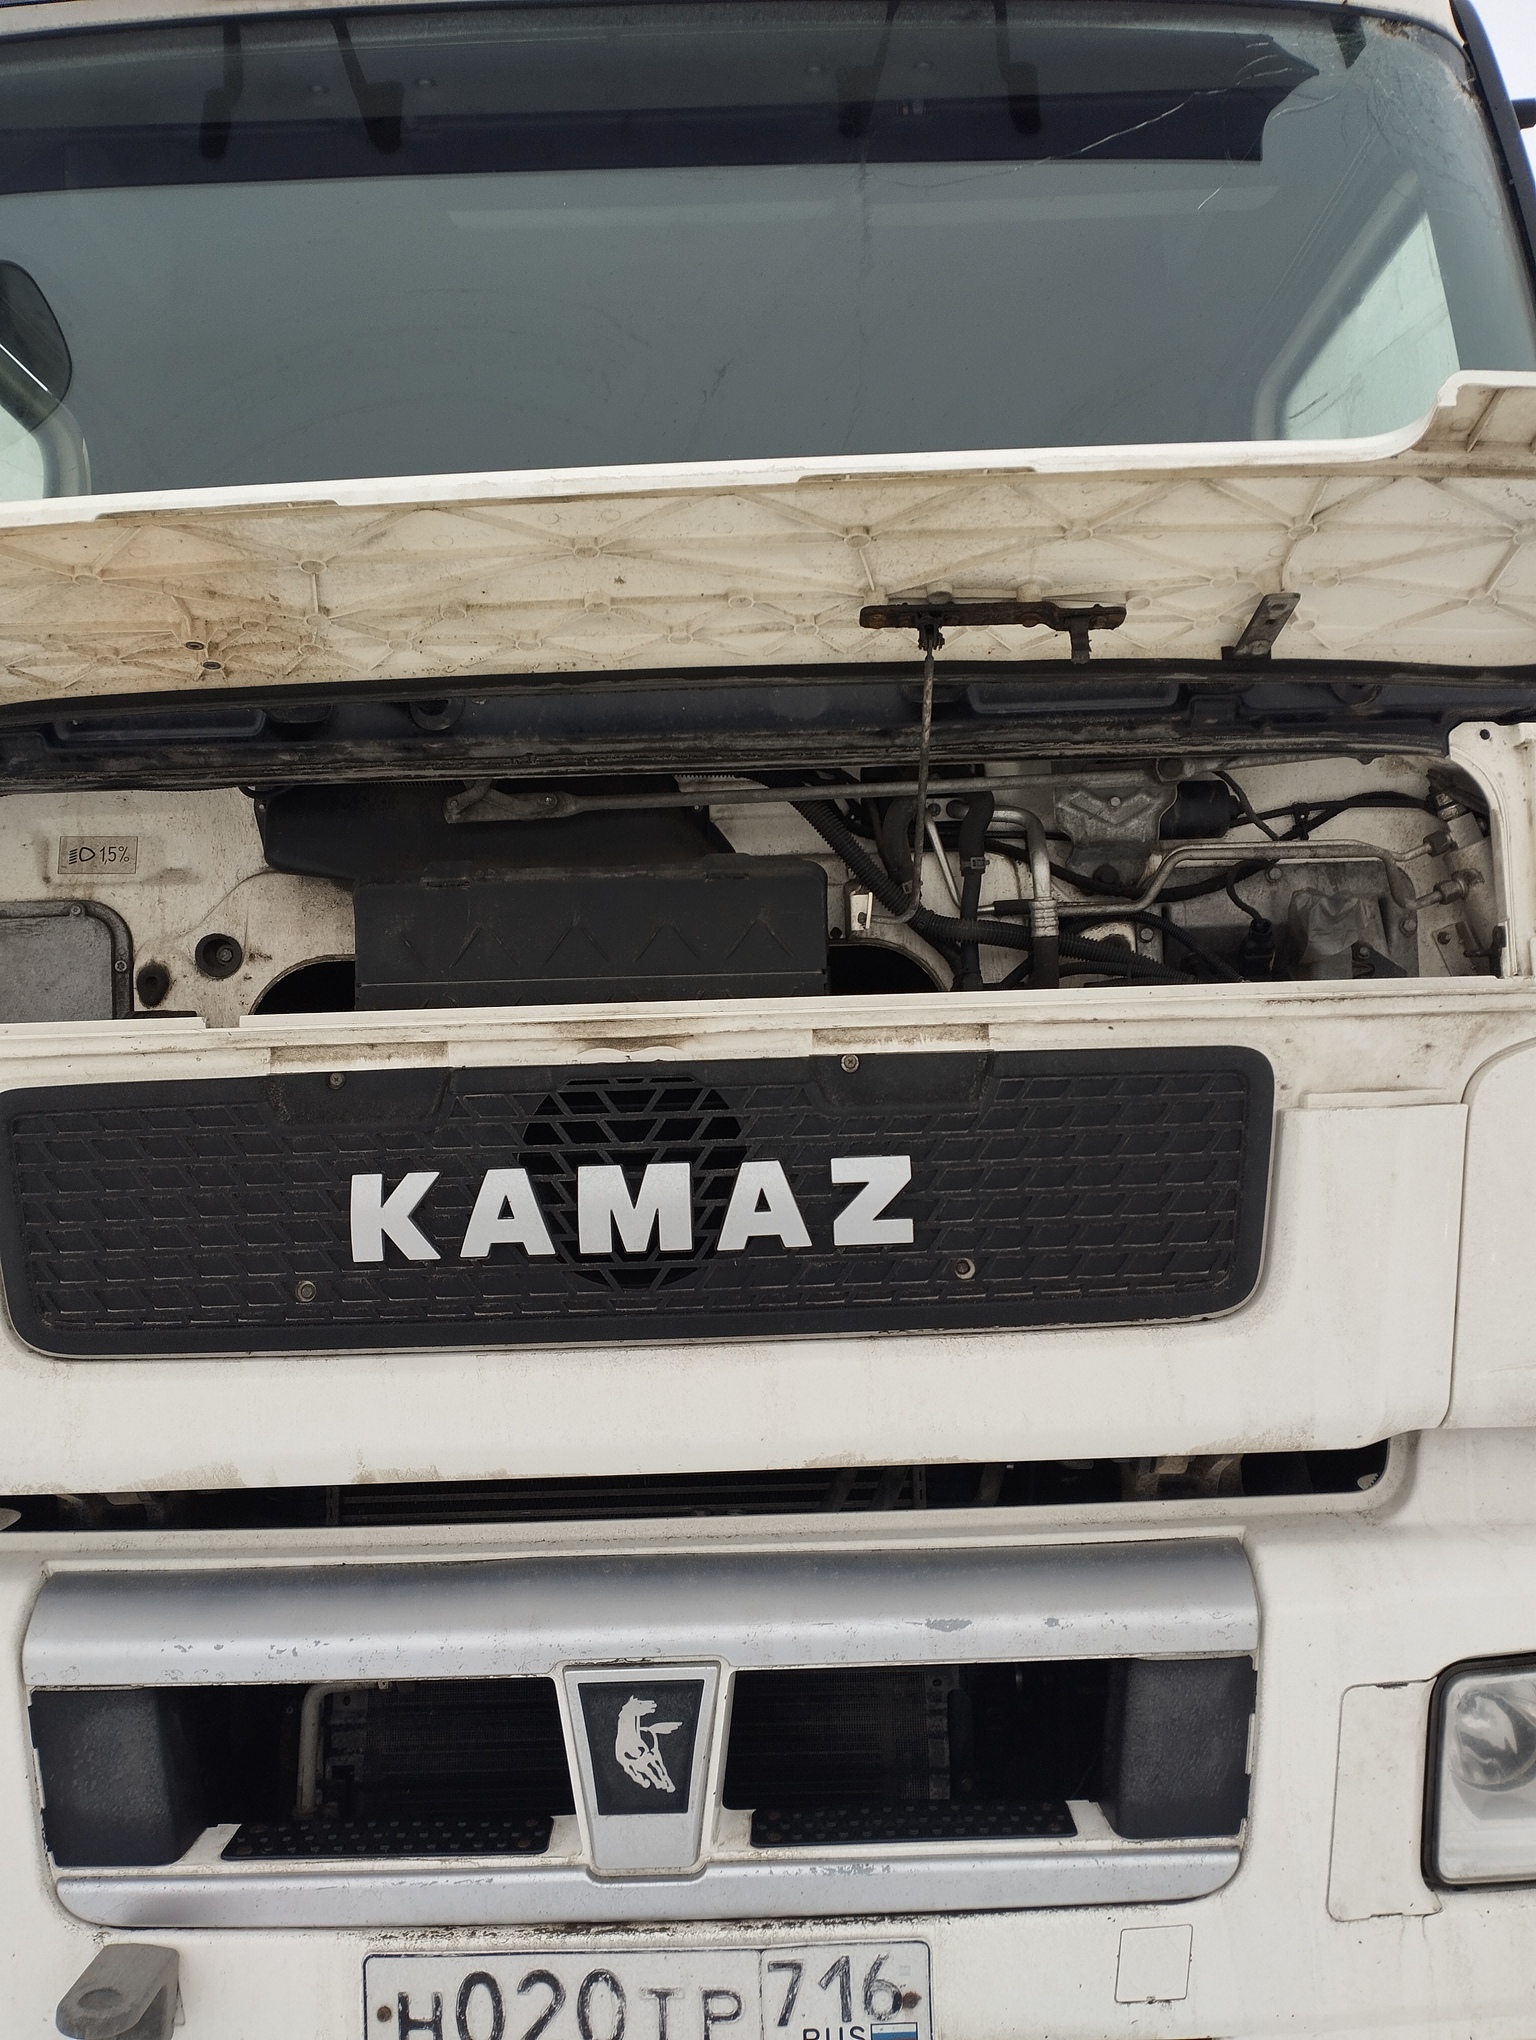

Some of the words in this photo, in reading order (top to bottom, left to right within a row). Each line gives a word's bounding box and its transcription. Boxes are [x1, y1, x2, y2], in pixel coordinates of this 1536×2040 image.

[100, 846, 130, 865] 1,5%
[350, 1155, 914, 1263] KAMAZ
[767, 1953, 903, 2026] 716
